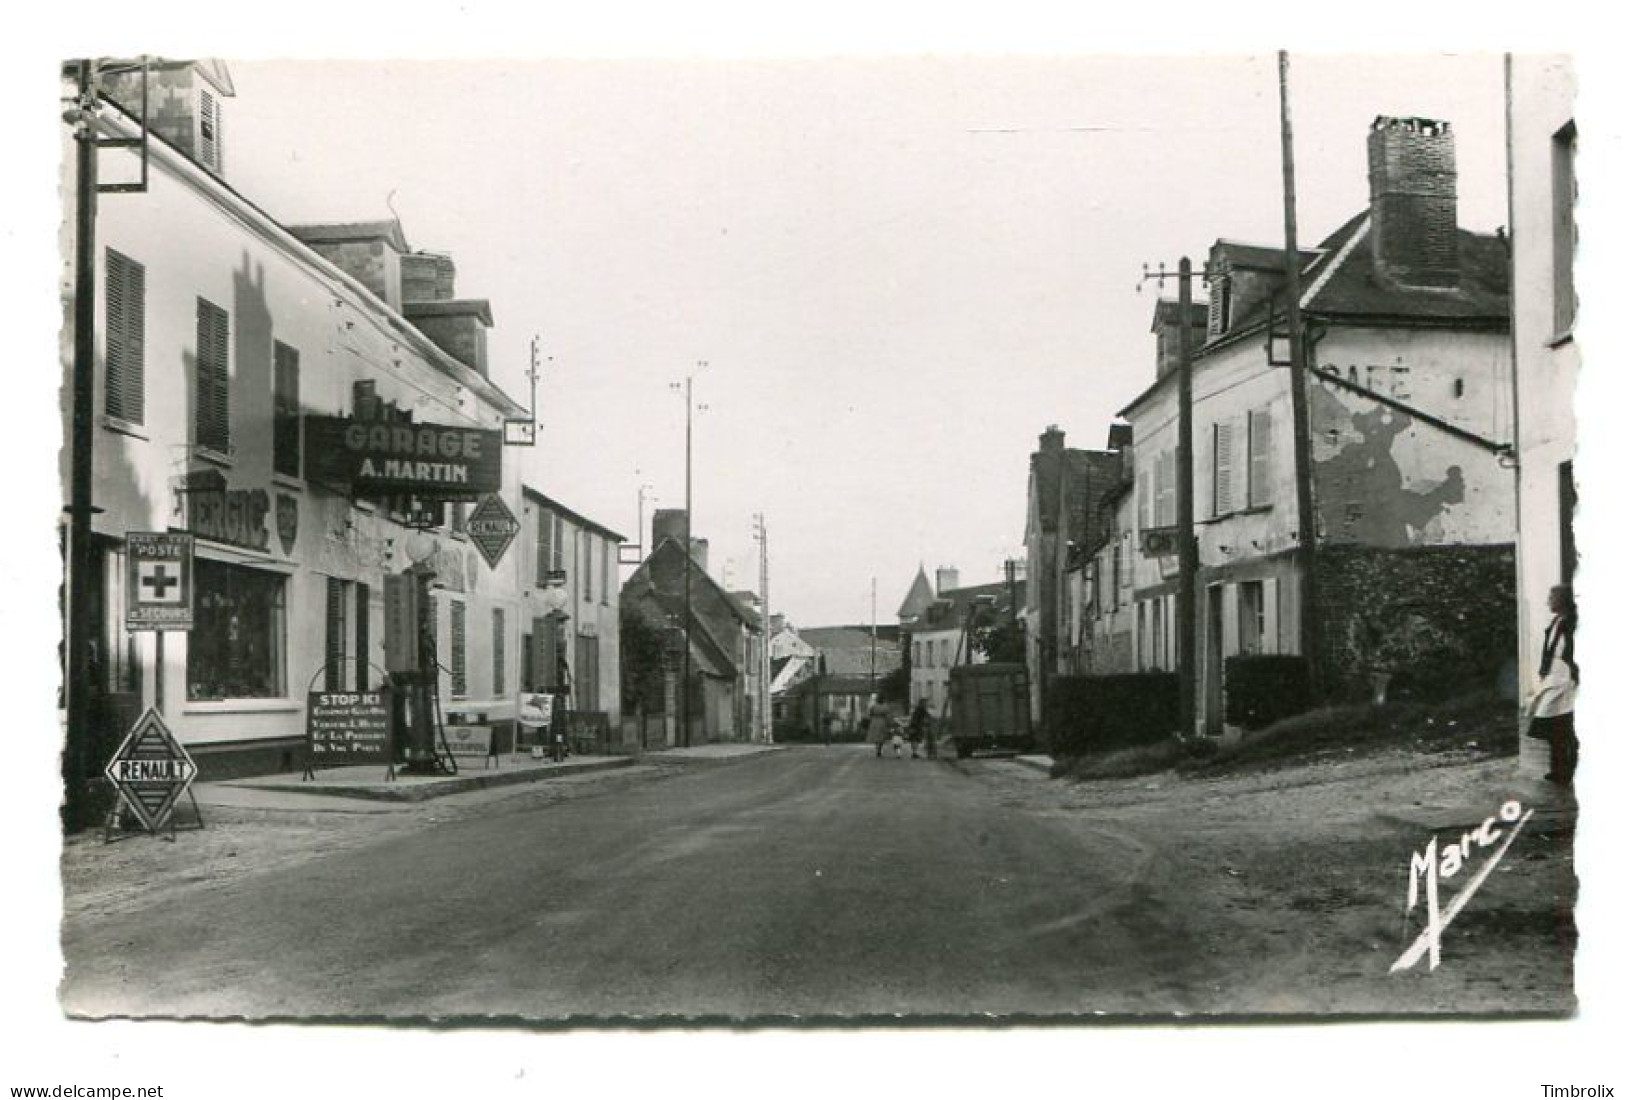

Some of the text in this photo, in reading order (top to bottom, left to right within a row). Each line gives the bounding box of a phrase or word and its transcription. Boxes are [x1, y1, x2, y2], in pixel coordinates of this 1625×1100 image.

[345, 424, 482, 459] GARAGE
[138, 544, 182, 557] POSTE
[320, 694, 380, 706] STOP ICI
[120, 761, 184, 779] RENAULT
